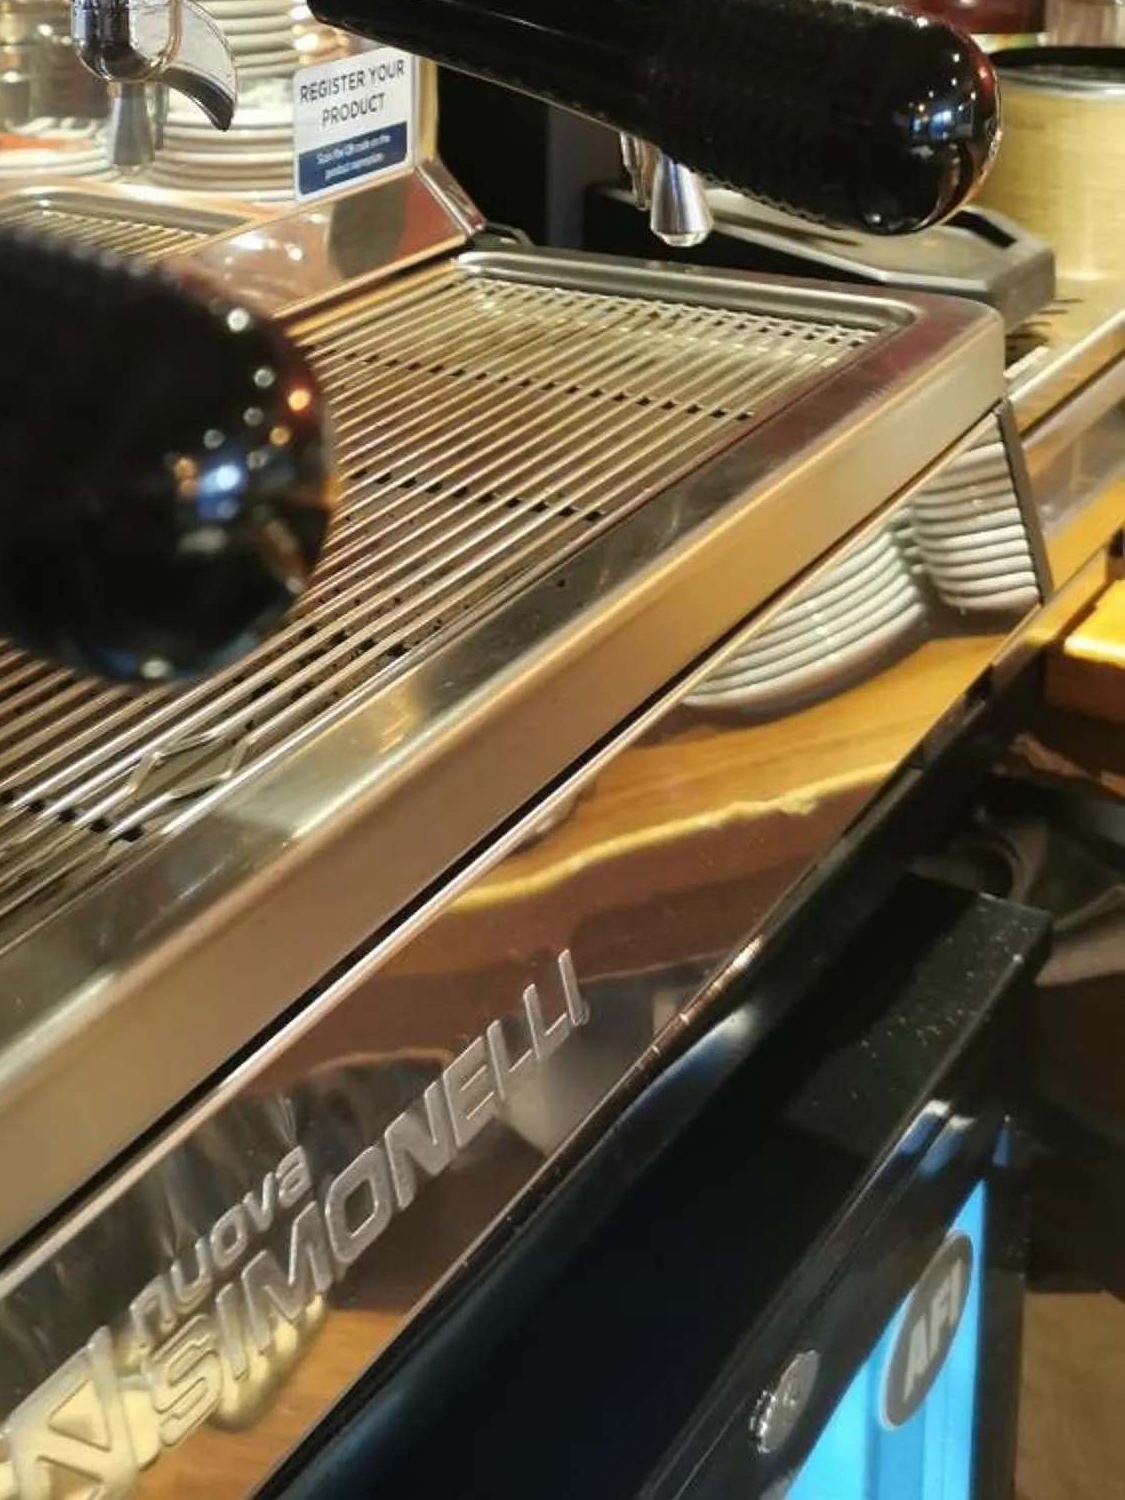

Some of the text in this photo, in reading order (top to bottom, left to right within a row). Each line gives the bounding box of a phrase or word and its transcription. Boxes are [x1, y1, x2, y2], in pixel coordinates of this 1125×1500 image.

[300, 58, 405, 104] REGISTER YOUR
[321, 92, 385, 127] PRODUCT
[128, 1144, 312, 1356] nuova
[150, 947, 589, 1448] SIMONELLI
